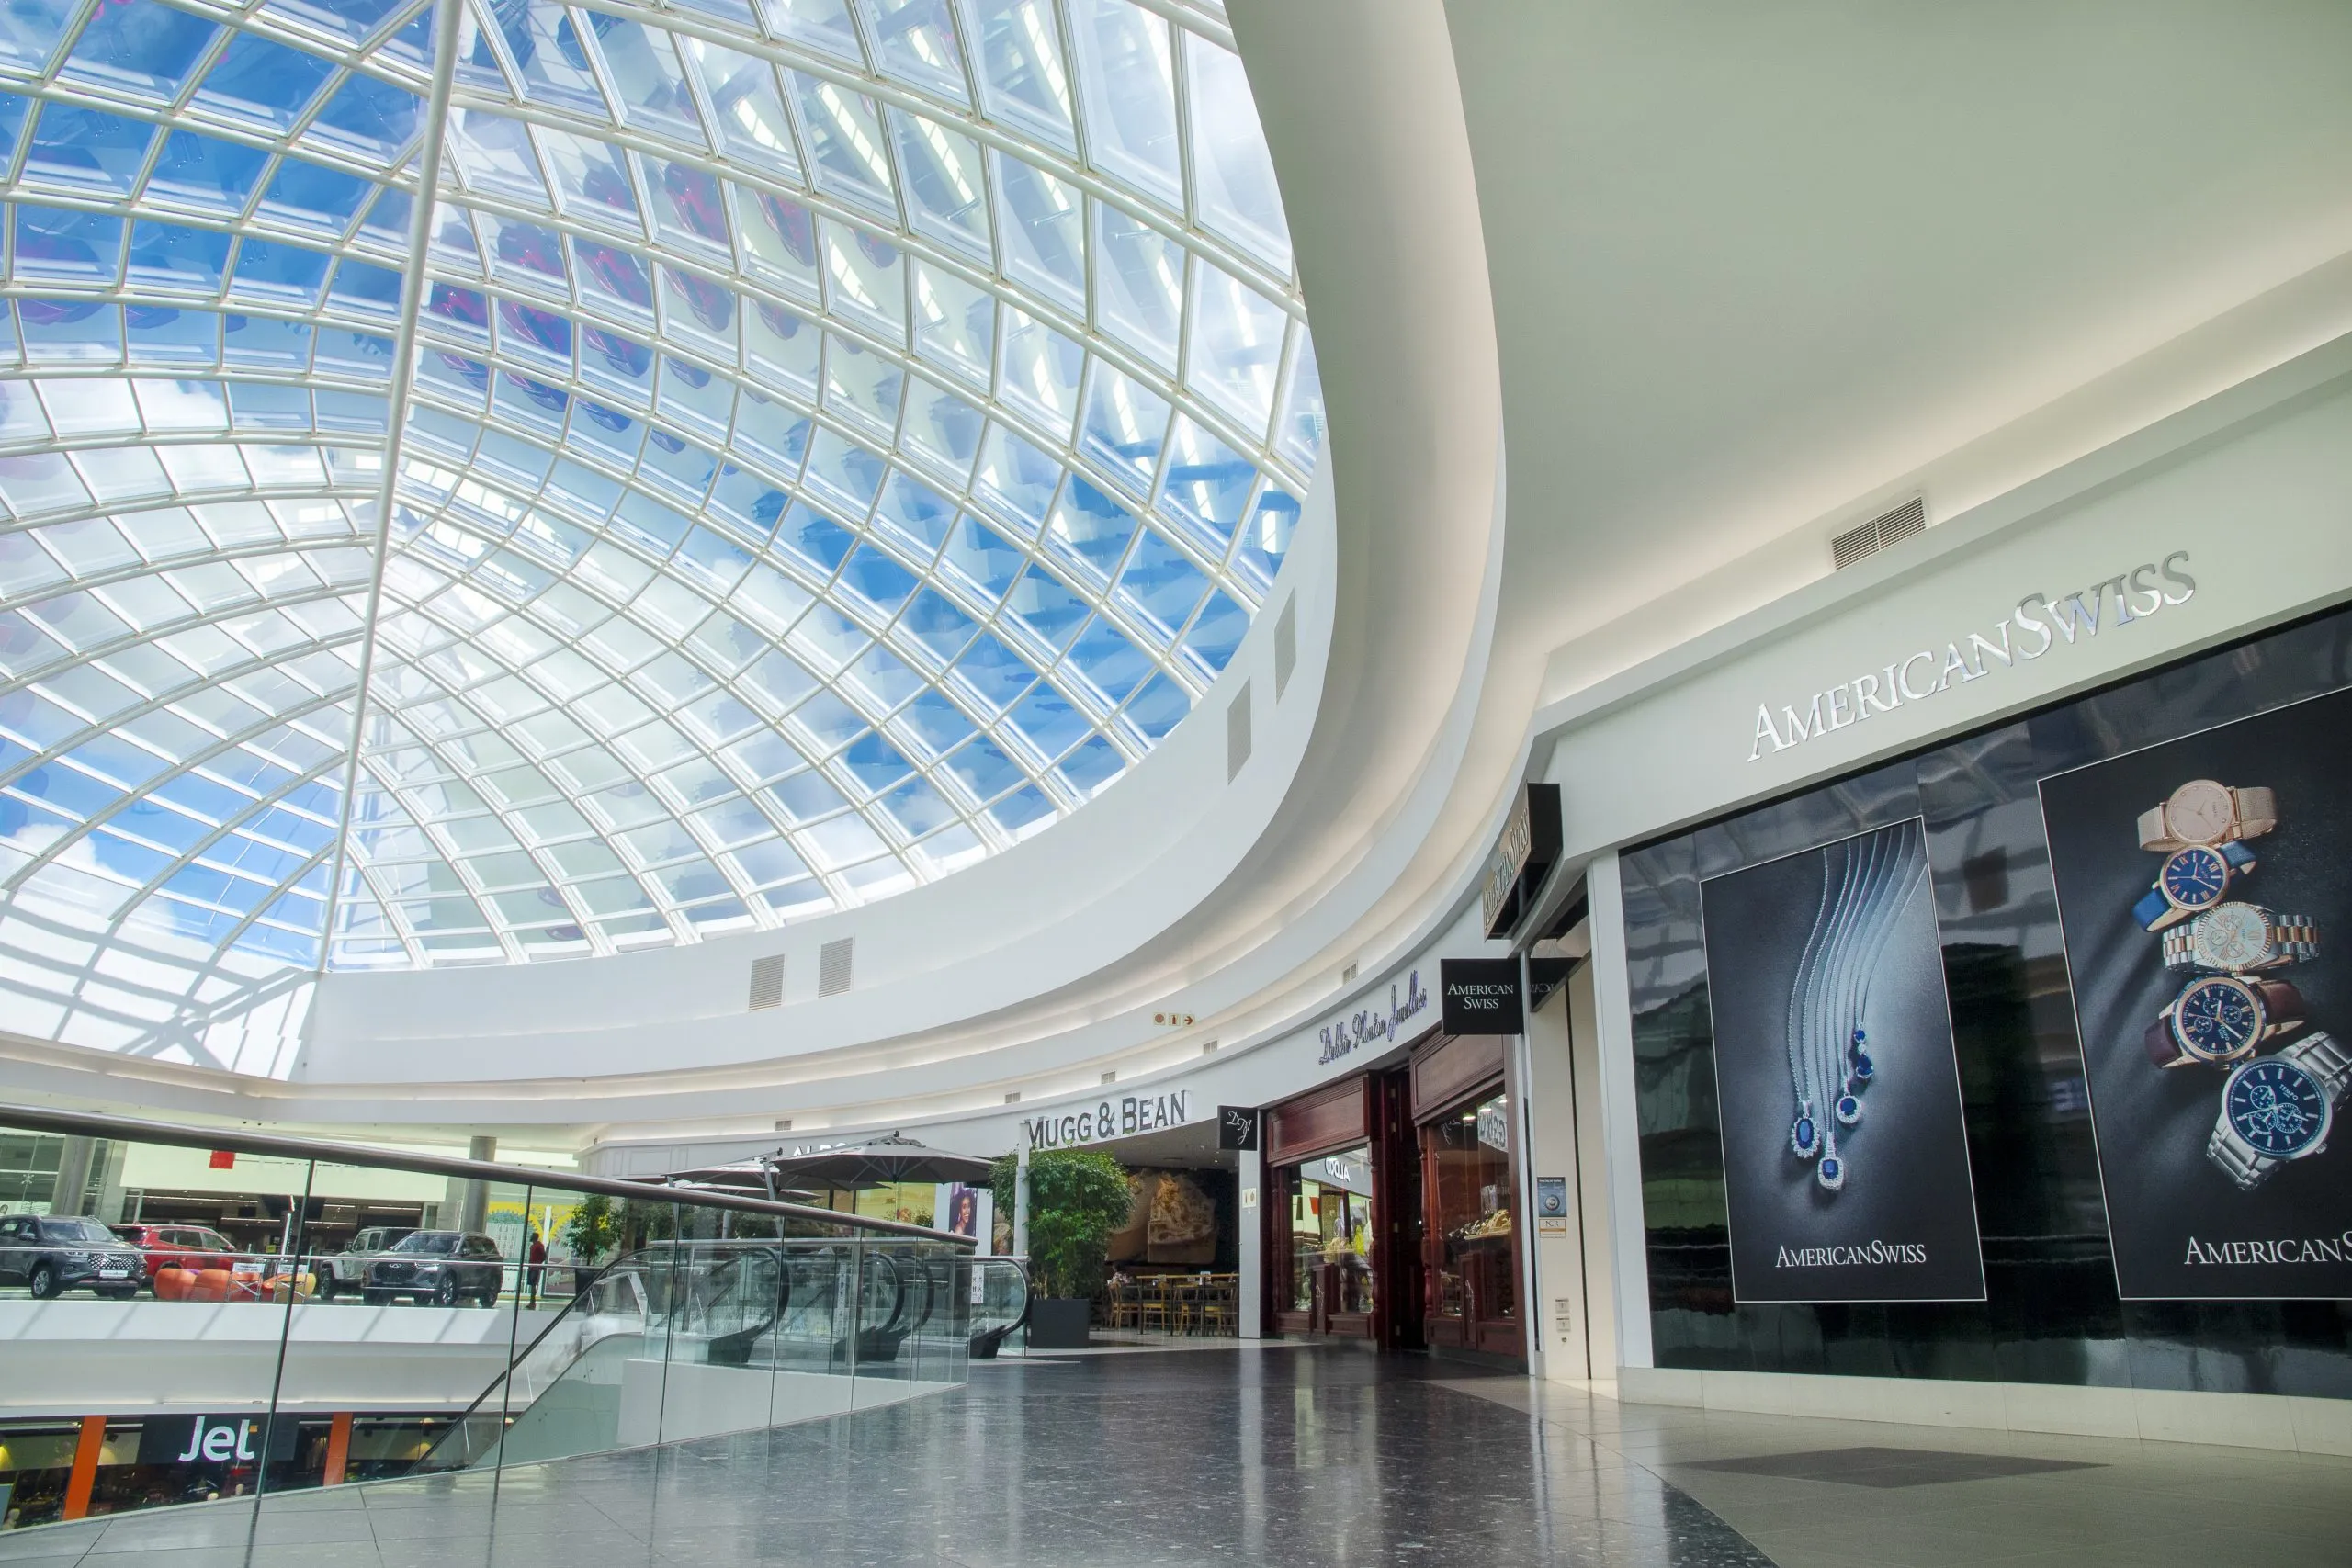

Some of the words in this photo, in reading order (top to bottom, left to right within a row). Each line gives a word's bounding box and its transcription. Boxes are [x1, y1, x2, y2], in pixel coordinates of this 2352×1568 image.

[1447, 982, 1514, 995] AMERICAN
[1464, 996, 1499, 1010] SWISS
[2279, 1084, 2299, 1100] TEMPO
[1025, 1111, 1091, 1150] MUGG
[1097, 1101, 1115, 1139] &
[1122, 1089, 1186, 1134] BEAN
[177, 1416, 255, 1461] Jet
